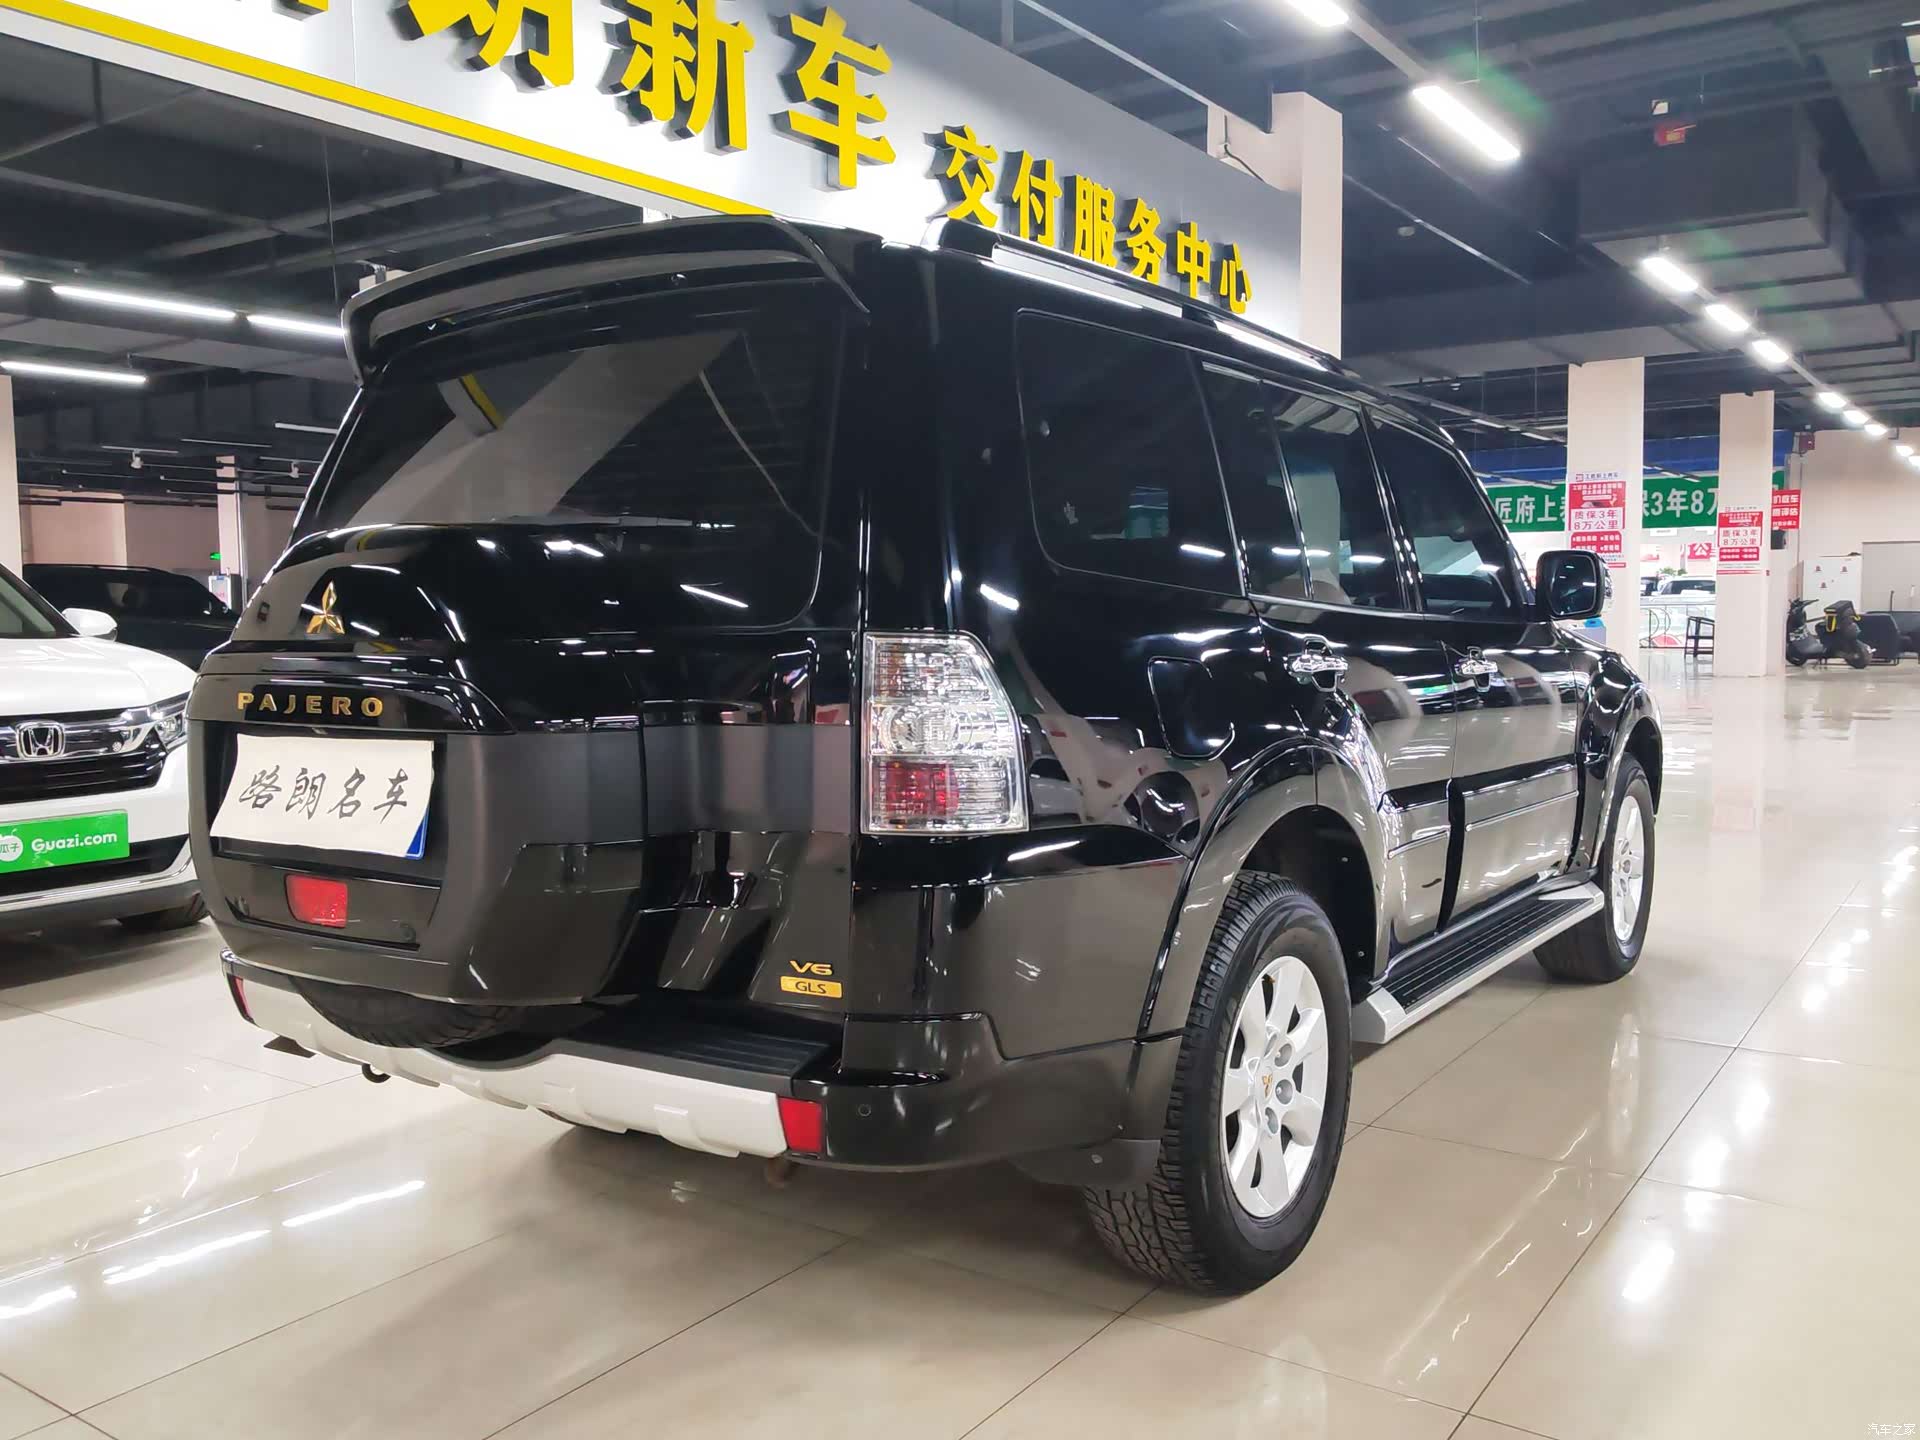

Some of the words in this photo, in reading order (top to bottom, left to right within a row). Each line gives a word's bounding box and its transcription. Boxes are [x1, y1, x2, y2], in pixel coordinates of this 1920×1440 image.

[941, 125, 1252, 314] 交付服务中心
[1494, 495, 1566, 524] 匠府上
[1574, 510, 1618, 520] 质保3年
[1573, 520, 1618, 530] 8万公里
[236, 691, 385, 718] PAJERO
[238, 764, 409, 824] 路朗名车
[31, 832, 118, 852] Guazi.com
[789, 960, 833, 976] V6
[795, 981, 827, 995] GLS
